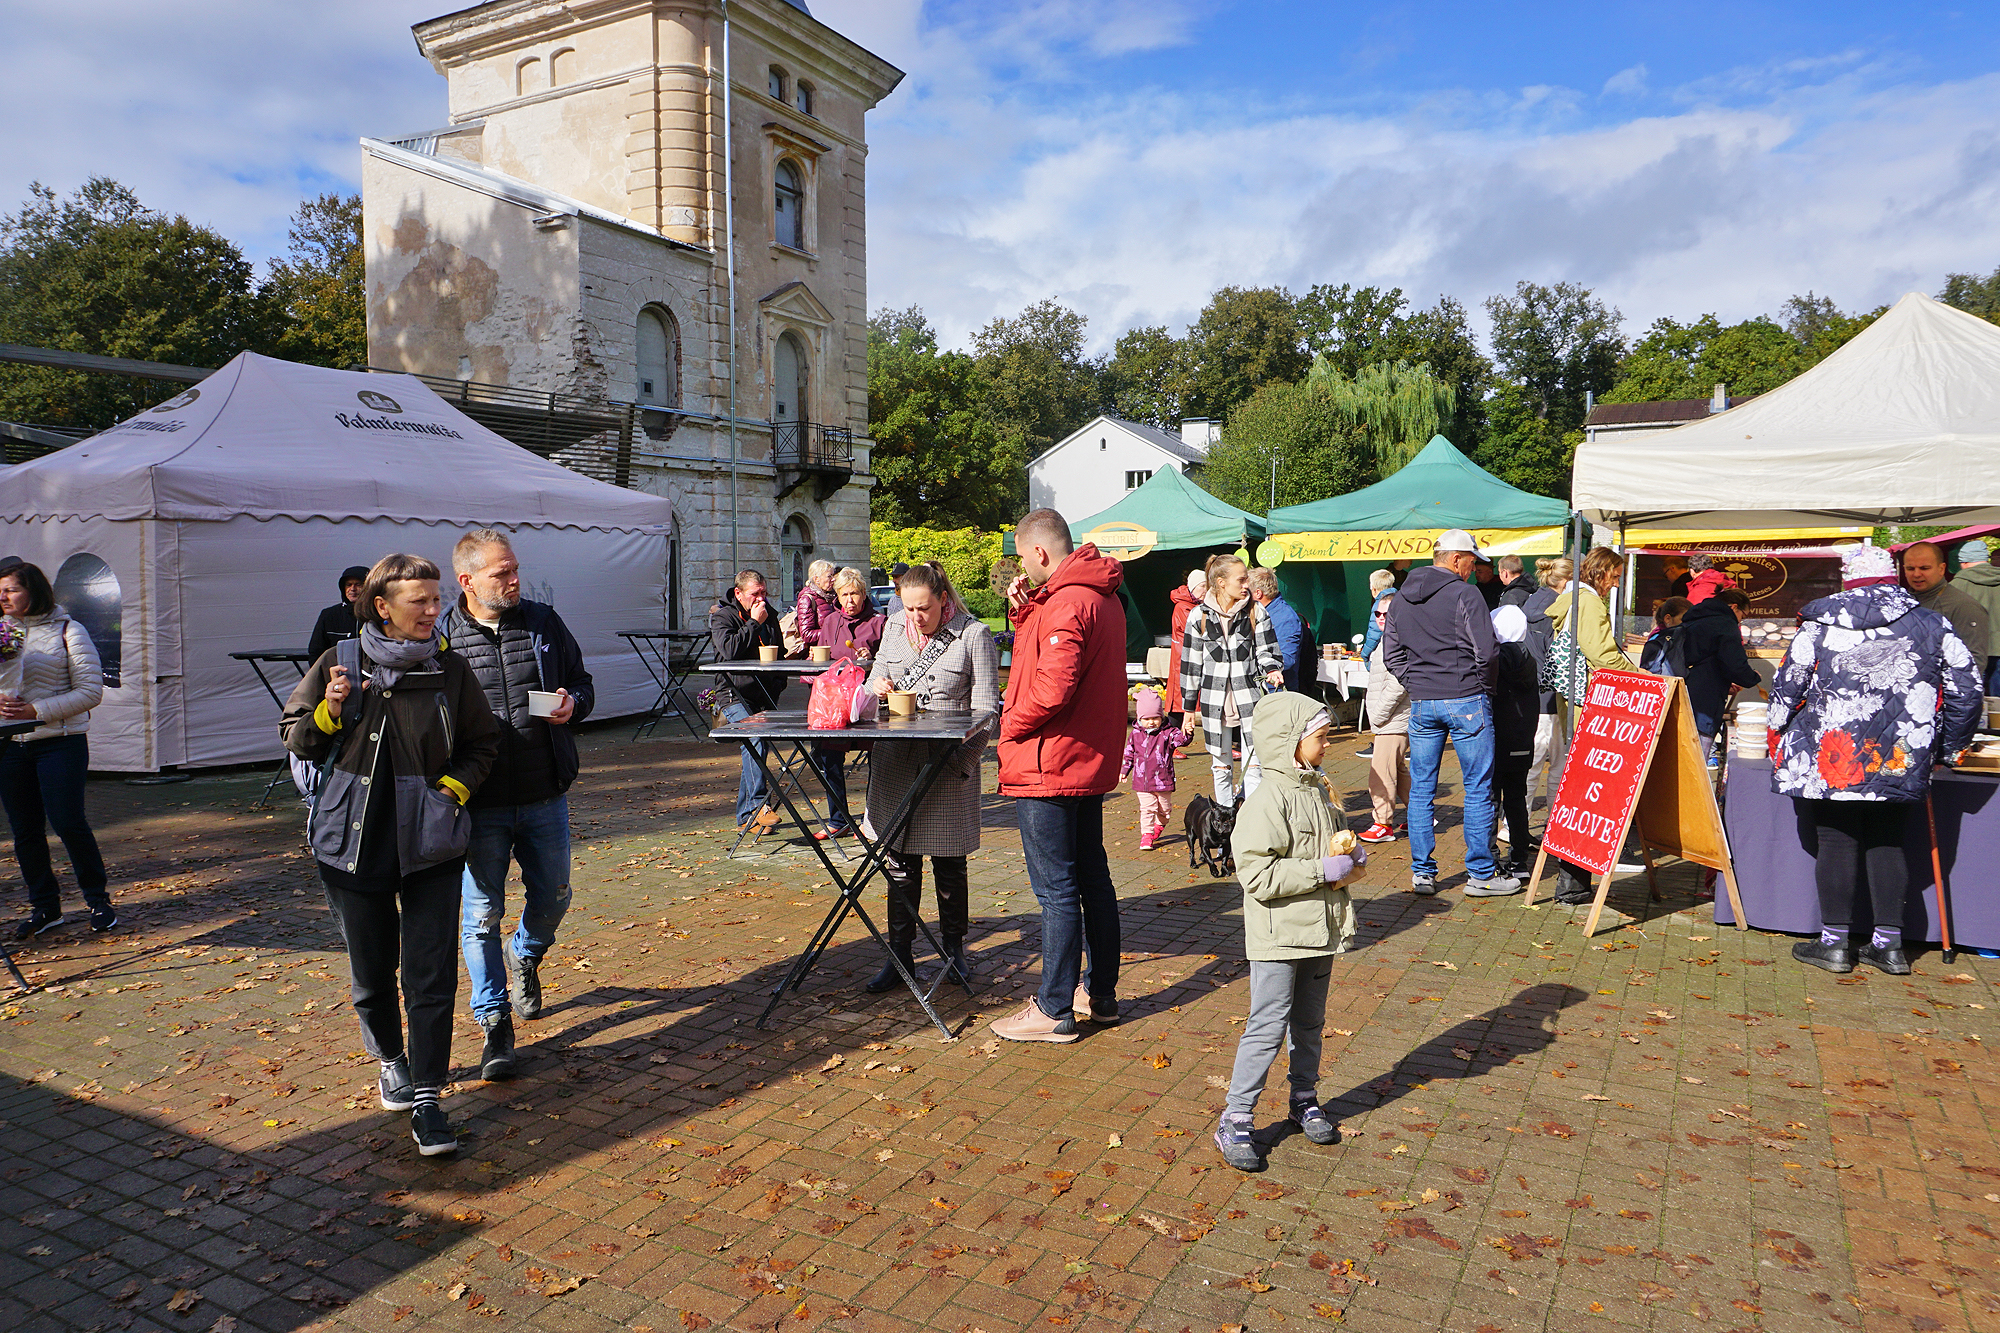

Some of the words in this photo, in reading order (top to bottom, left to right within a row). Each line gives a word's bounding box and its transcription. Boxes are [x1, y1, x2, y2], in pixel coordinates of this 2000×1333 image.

[1347, 534, 1492, 556] ASINSDS
[1590, 683, 1616, 708] NATA
[1627, 690, 1660, 717] CAFE
[1585, 714, 1611, 737] ALL
[1611, 719, 1645, 745] YOU
[1584, 746, 1624, 774] NEED
[1584, 781, 1604, 803] IS
[1555, 804, 1616, 844] (P)LOVE
